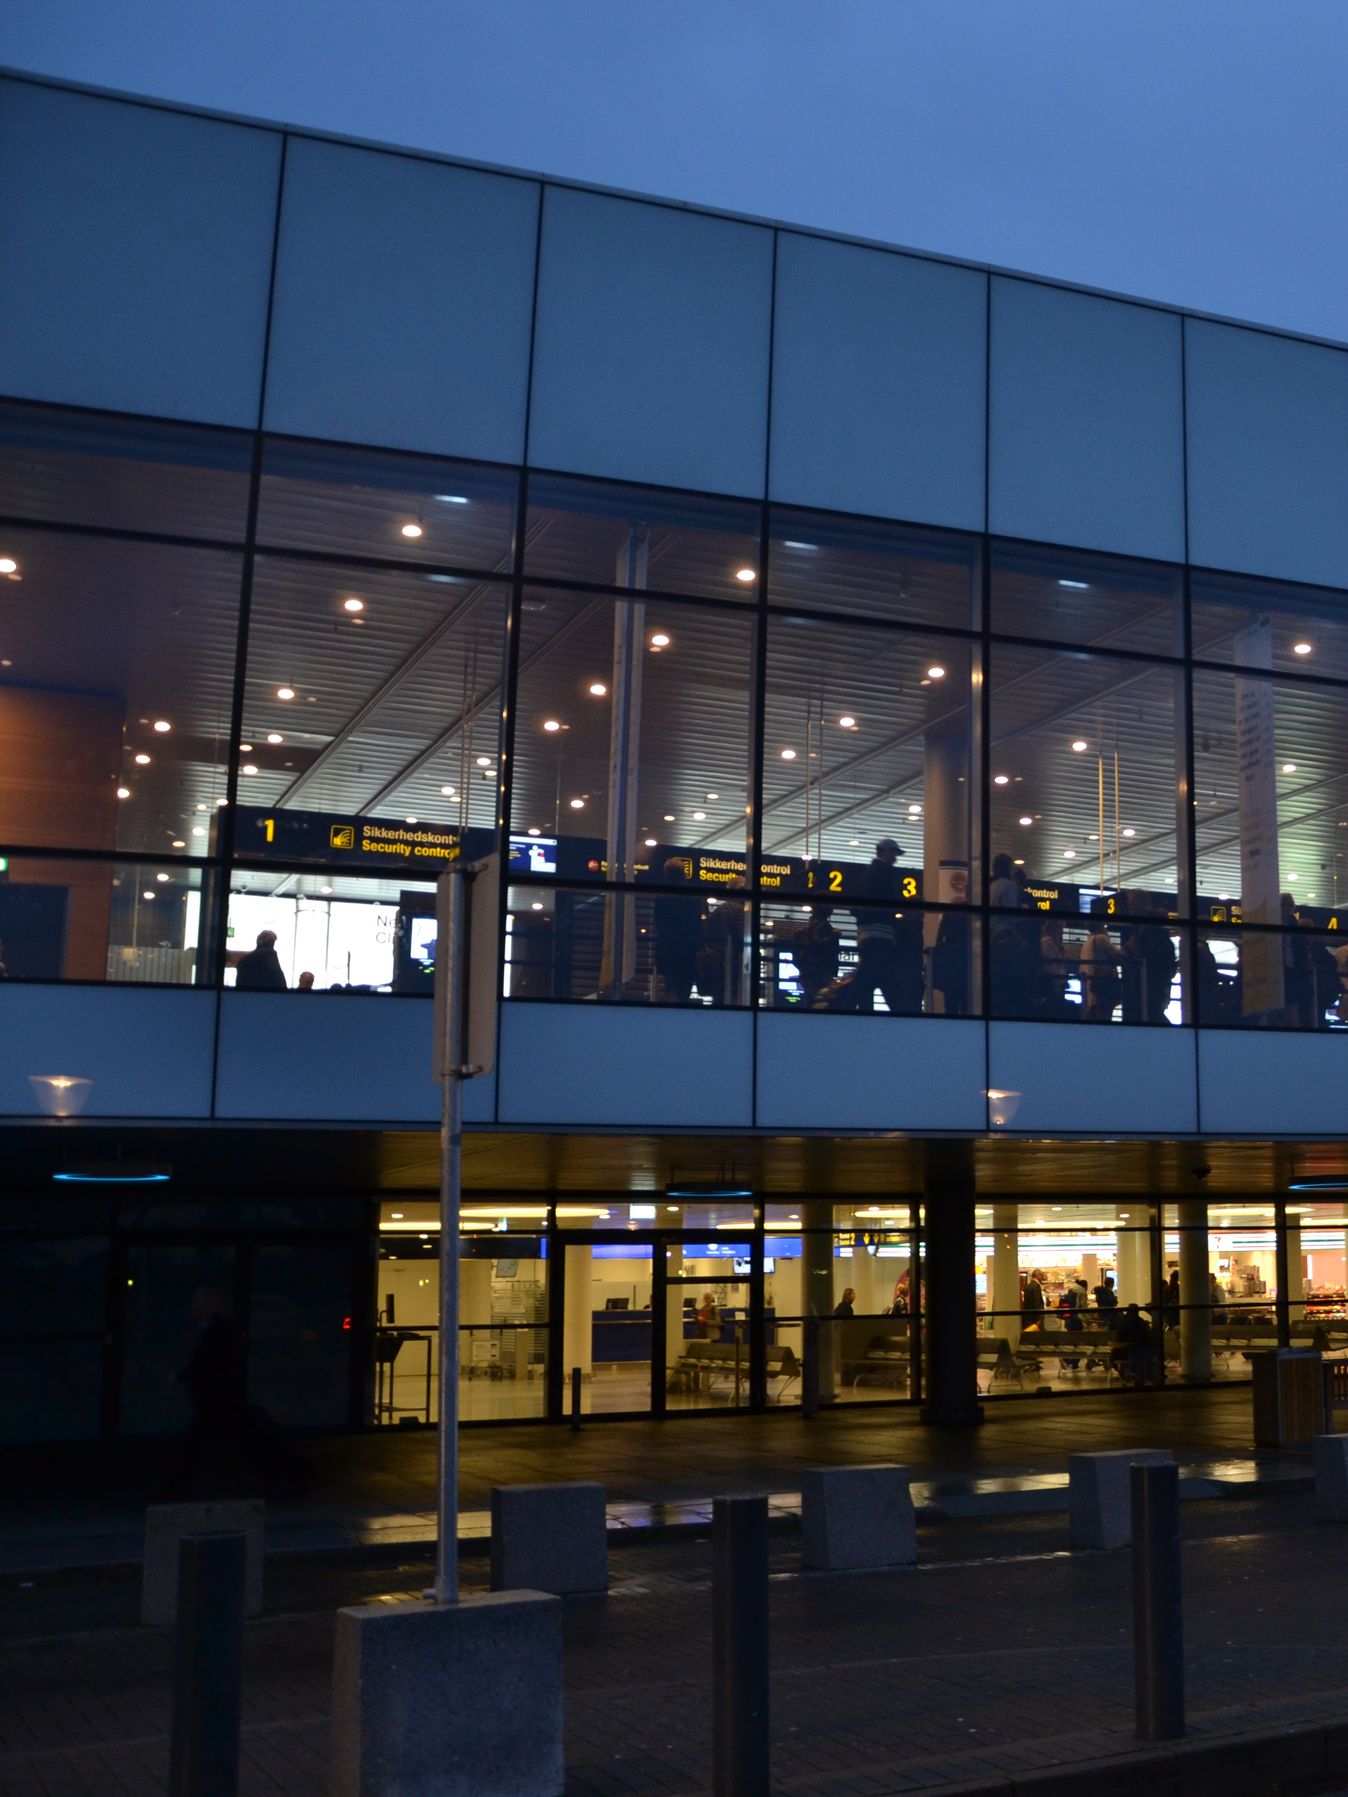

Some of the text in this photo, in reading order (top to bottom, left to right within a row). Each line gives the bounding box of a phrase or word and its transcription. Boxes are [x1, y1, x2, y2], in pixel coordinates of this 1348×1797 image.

[264, 819, 274, 842] 1
[362, 839, 411, 857] Security
[828, 870, 843, 892] 2
[902, 877, 917, 898] 3
[1107, 898, 1116, 915] 3
